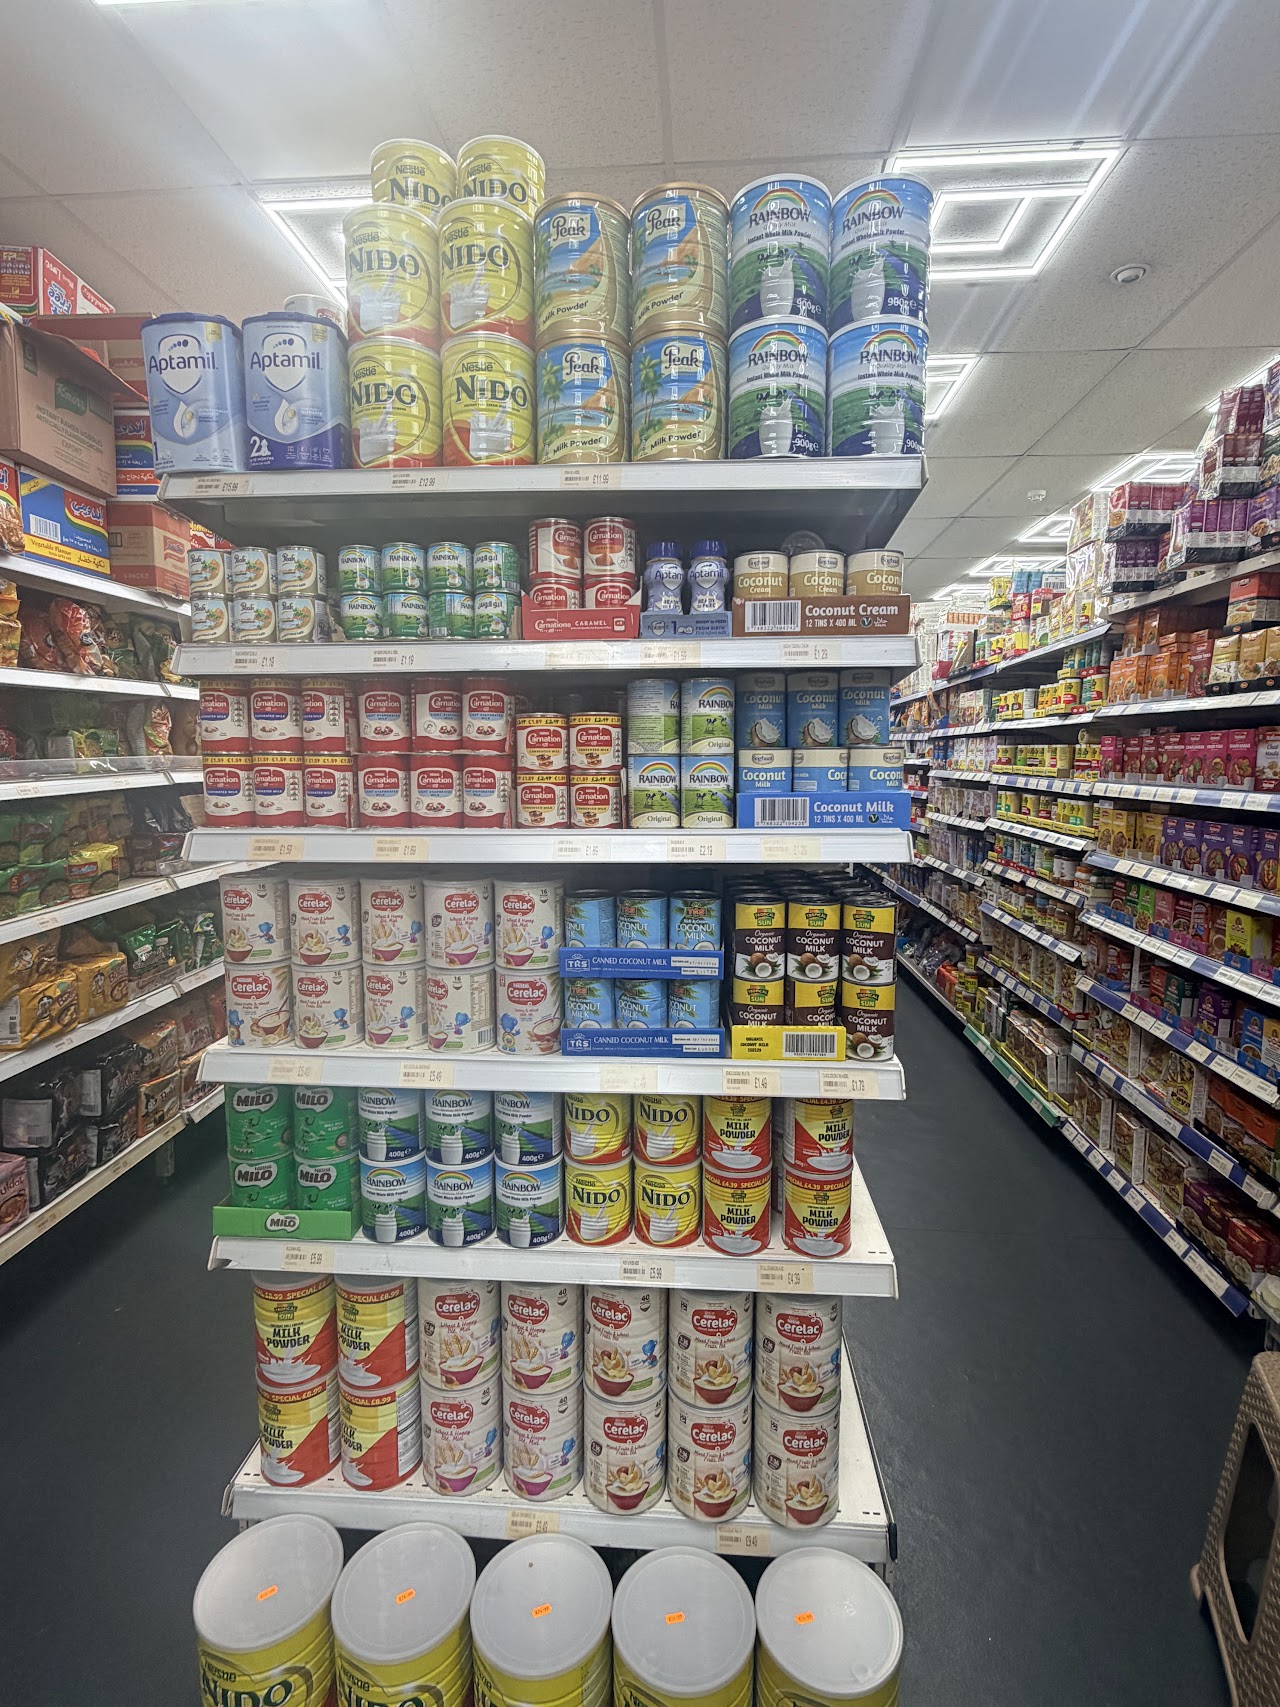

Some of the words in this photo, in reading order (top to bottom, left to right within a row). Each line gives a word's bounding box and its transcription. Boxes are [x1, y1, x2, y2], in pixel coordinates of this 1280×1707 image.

[462, 177, 528, 198] NIDO
[647, 208, 681, 235] Peak
[749, 207, 812, 227] RAINBOW
[842, 206, 906, 233] RAINBOW
[552, 214, 586, 241] Peak
[651, 291, 683, 310] Powder
[557, 300, 588, 316] Powder
[250, 351, 320, 371] Aptamil
[565, 350, 599, 374] Peak
[663, 345, 700, 368] Peak
[748, 349, 810, 368] RAINBOW
[149, 351, 217, 374] Aptamil
[461, 361, 493, 372] Nestlé
[455, 375, 528, 407] NIDO
[553, 440, 568, 455] Milk
[569, 435, 602, 448] Powder
[650, 435, 667, 450] Milk
[668, 430, 701, 442] Powder
[250, 436, 262, 456] 2
[593, 474, 609, 484] £11.99
[589, 530, 622, 542] Carnation
[31, 539, 53, 550] Vegetable
[690, 570, 724, 580] Aptamil
[738, 575, 783, 588] Coconut
[805, 605, 856, 616] Coconut
[859, 604, 898, 615] Cream
[671, 620, 677, 634] 1
[815, 619, 828, 627] TINS
[842, 689, 885, 700] Coconut
[254, 698, 285, 708] Carnation
[366, 698, 400, 709] Carnation
[528, 733, 560, 744] Carnation
[578, 732, 610, 743] Carnation
[207, 774, 239, 784] Carnation
[639, 774, 677, 784] RAINBOW
[689, 774, 730, 784] RAINBOW
[742, 769, 786, 781] Coconut
[522, 790, 553, 800] Carnation
[576, 791, 608, 802] Carnation
[814, 801, 862, 813] Coconut
[866, 801, 894, 813] Milk
[647, 815, 672, 823] Original
[698, 815, 723, 823] Original
[813, 815, 820, 823] 12
[822, 815, 836, 823] TINS
[837, 815, 841, 823] X
[843, 815, 854, 823] 400
[855, 815, 864, 823] ML
[446, 900, 476, 909] Cerelac
[503, 901, 532, 910] Cerelac
[806, 930, 826, 938] Organic
[853, 931, 874, 939] Organic
[745, 936, 781, 944] COCONUT
[796, 936, 835, 944] COCONUT
[846, 937, 884, 947] COCONUT
[805, 944, 825, 952] MILK
[853, 946, 873, 954] MILK
[568, 960, 589, 968] TRS
[592, 957, 618, 965] CANNED
[619, 957, 651, 965] COCONUT
[232, 982, 270, 992] Cerelac
[507, 988, 544, 998] Cerelac
[739, 1012, 777, 1020] COCONUT
[848, 1015, 887, 1025] COCONUT
[857, 1024, 878, 1032] MILK
[754, 1077, 767, 1089] £1.49
[852, 1079, 865, 1091] £1.79
[236, 1092, 273, 1107] MILO
[296, 1092, 327, 1106] MILO
[432, 1098, 474, 1108] RAINBOW
[566, 1101, 610, 1123] NIDO
[640, 1101, 687, 1122] NIDO
[726, 1121, 749, 1130] MILK
[826, 1122, 846, 1132] MILK
[720, 1128, 756, 1139] POWDER
[818, 1130, 850, 1141] POWDER
[237, 1170, 272, 1182] MILO
[300, 1170, 332, 1183] MILO
[367, 1177, 407, 1187] RAINBOW
[434, 1180, 475, 1190] RAINBOW
[502, 1180, 542, 1192] RAINBOW
[722, 1180, 738, 1188] £4.39
[740, 1179, 761, 1188] SPECIAL
[804, 1182, 820, 1190] £4.39
[823, 1181, 844, 1190] SPECIAL
[572, 1184, 620, 1204] NIDO
[642, 1185, 690, 1206] NIDO
[270, 1218, 296, 1228] MILO
[720, 1215, 756, 1225] POWDER
[802, 1217, 838, 1227] POWDER
[466, 1233, 481, 1242] 400g
[533, 1236, 548, 1244] 400g
[310, 1254, 322, 1264] £5.99
[649, 1268, 662, 1279] £5.99
[788, 1274, 800, 1285] £4.39
[286, 1285, 316, 1300] SPECIAL
[350, 1293, 379, 1302] SPECIAL
[380, 1289, 400, 1300] £8.99
[558, 1288, 567, 1296] 40
[436, 1302, 477, 1313] Cerelac
[509, 1304, 545, 1317] Cerelac
[592, 1307, 628, 1322] Cerelac
[777, 1319, 820, 1334] Cerelac
[266, 1335, 310, 1349] POWDER
[271, 1393, 301, 1402] SPECIAL
[301, 1387, 322, 1399] £8.99
[559, 1396, 568, 1404] 40
[370, 1397, 391, 1406] £8.99
[431, 1410, 470, 1421] Cerelac
[510, 1412, 546, 1425] Cerelac
